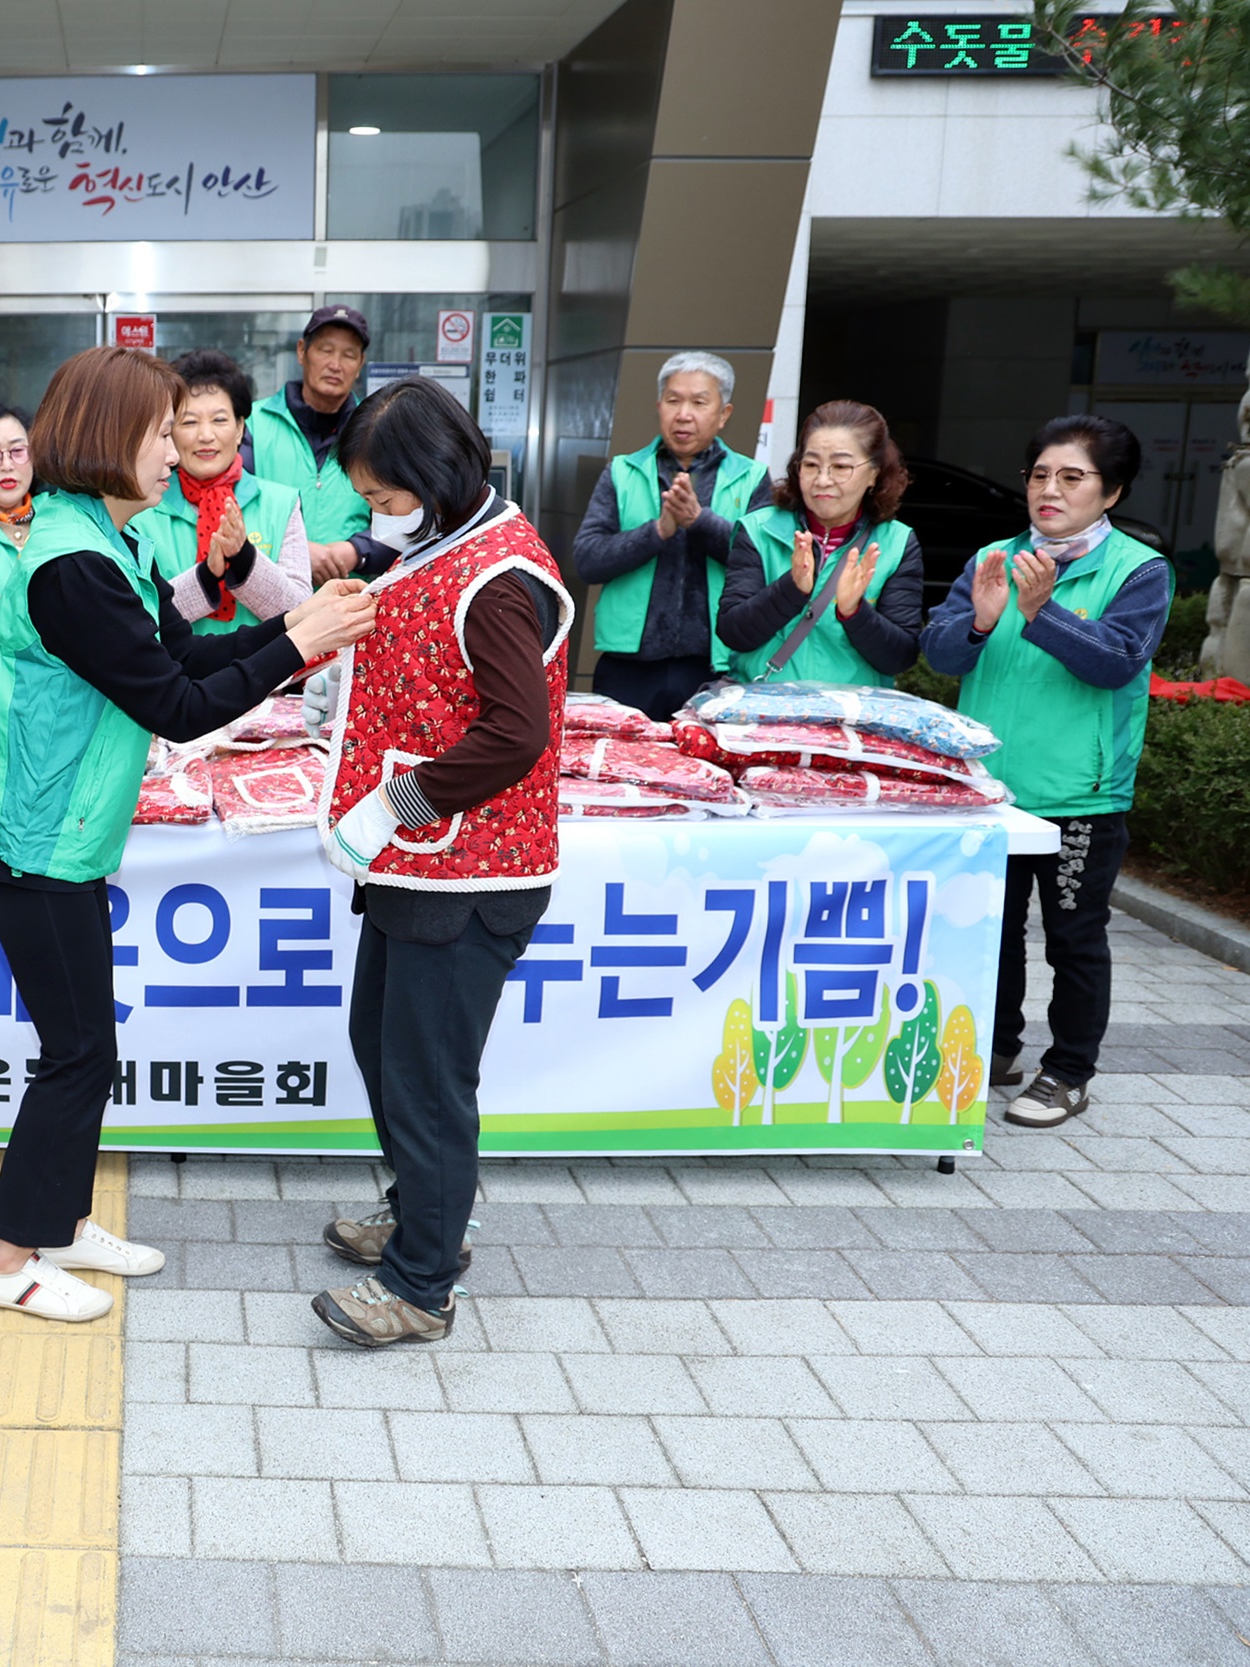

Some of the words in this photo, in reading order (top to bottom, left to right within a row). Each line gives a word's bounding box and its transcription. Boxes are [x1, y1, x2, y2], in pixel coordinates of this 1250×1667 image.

[890, 20, 1036, 69] 수돗물
[42, 101, 128, 159] 함께,
[68, 162, 195, 216] 혁신도시
[203, 165, 279, 199] 안산
[485, 351, 527, 366] 무더위
